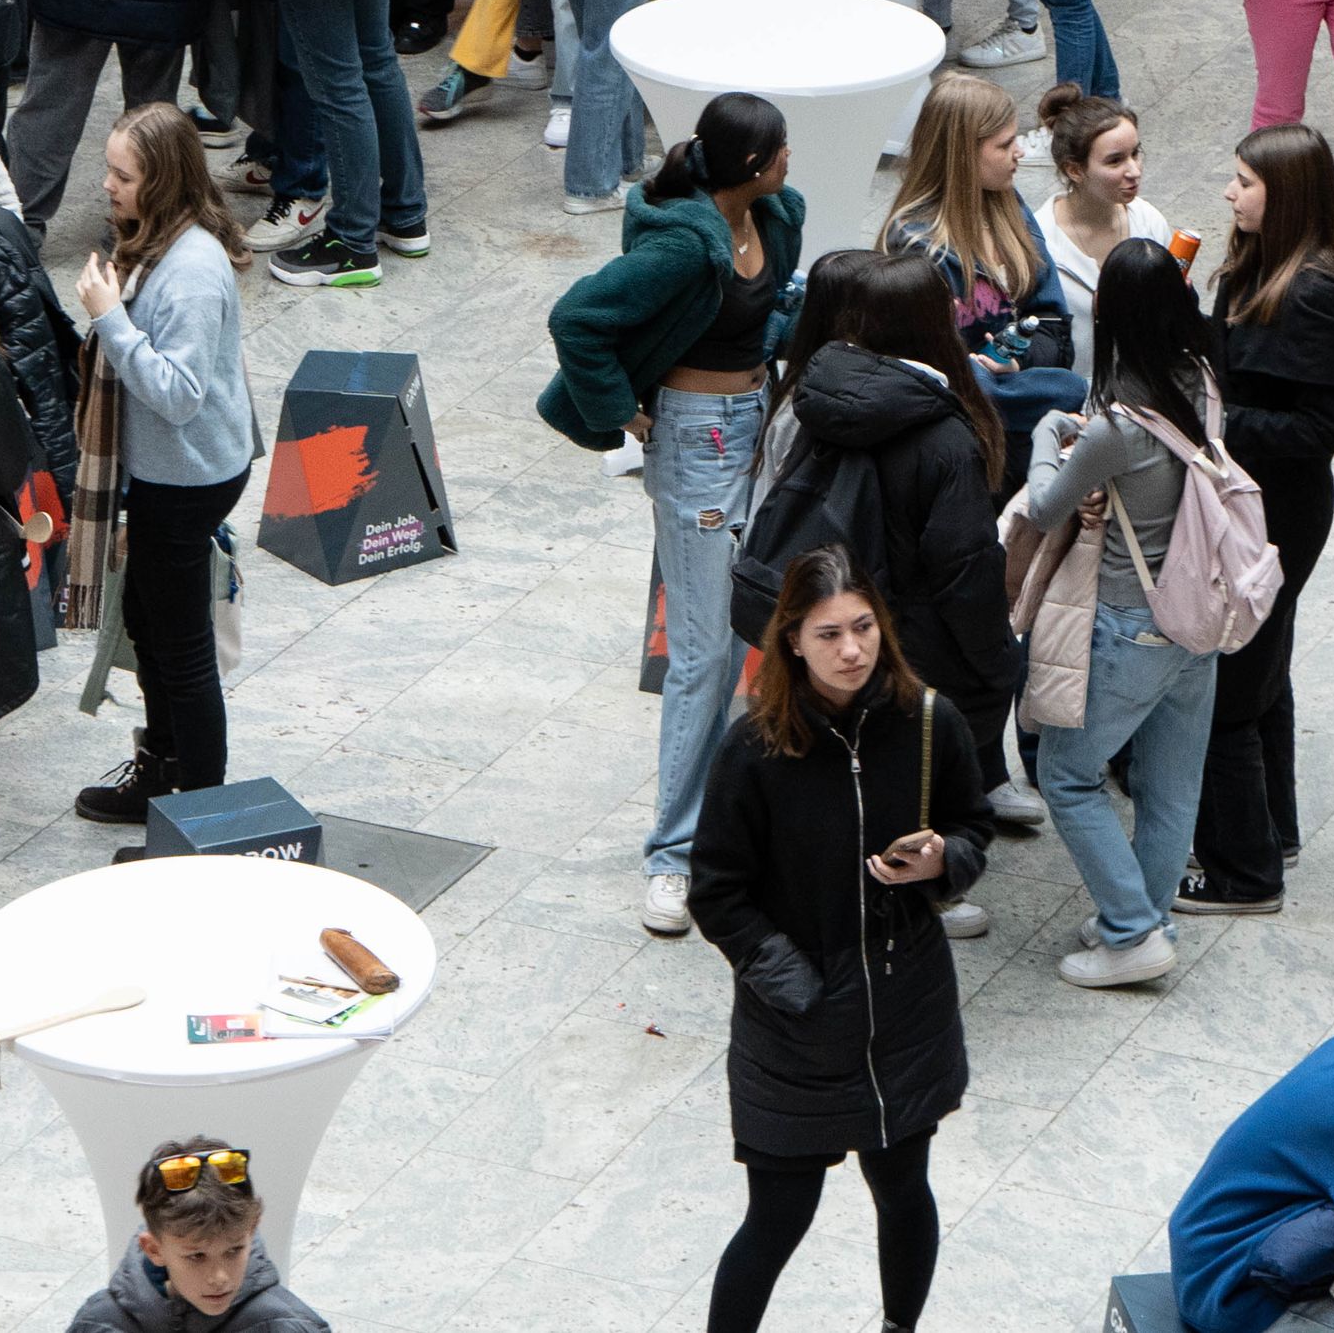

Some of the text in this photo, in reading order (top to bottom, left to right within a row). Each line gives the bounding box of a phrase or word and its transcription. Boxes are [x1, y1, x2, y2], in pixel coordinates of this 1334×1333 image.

[365, 513, 419, 536] Dein Job.
[362, 528, 421, 551] Dein Weg.
[358, 540, 424, 565] Dein Erfolg.
